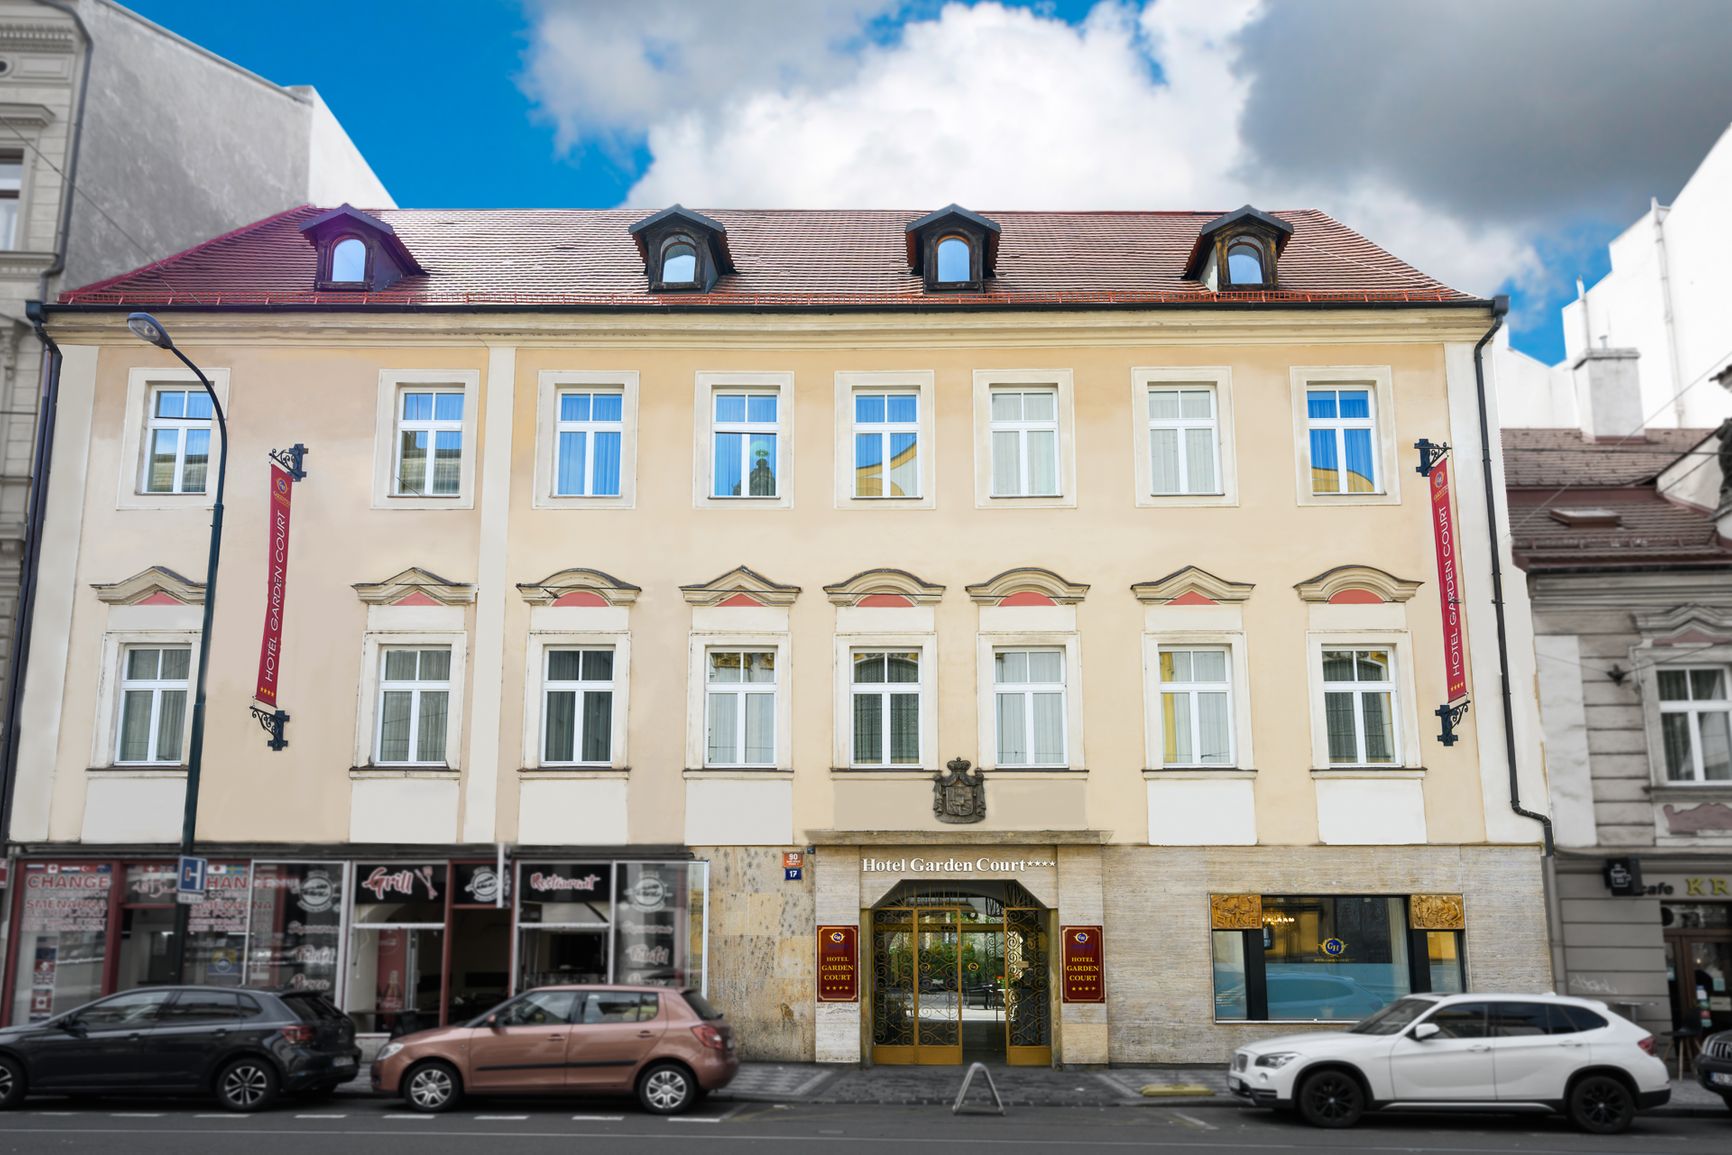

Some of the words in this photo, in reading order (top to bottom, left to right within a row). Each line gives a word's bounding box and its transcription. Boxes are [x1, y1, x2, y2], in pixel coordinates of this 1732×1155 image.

[274, 510, 286, 564] COURT
[1439, 506, 1451, 557] COURT
[270, 565, 283, 632] GARDEN
[1445, 560, 1457, 626] GARDEN
[264, 636, 277, 683] HOTEL
[1452, 629, 1461, 677] HOTEL
[27, 875, 109, 888] CHANGE
[362, 866, 413, 900] Grill
[530, 872, 601, 891] Restaurant
[789, 870, 798, 878] 17
[862, 858, 905, 872] Hotel
[910, 858, 973, 872] Garden
[976, 858, 1025, 872] Court
